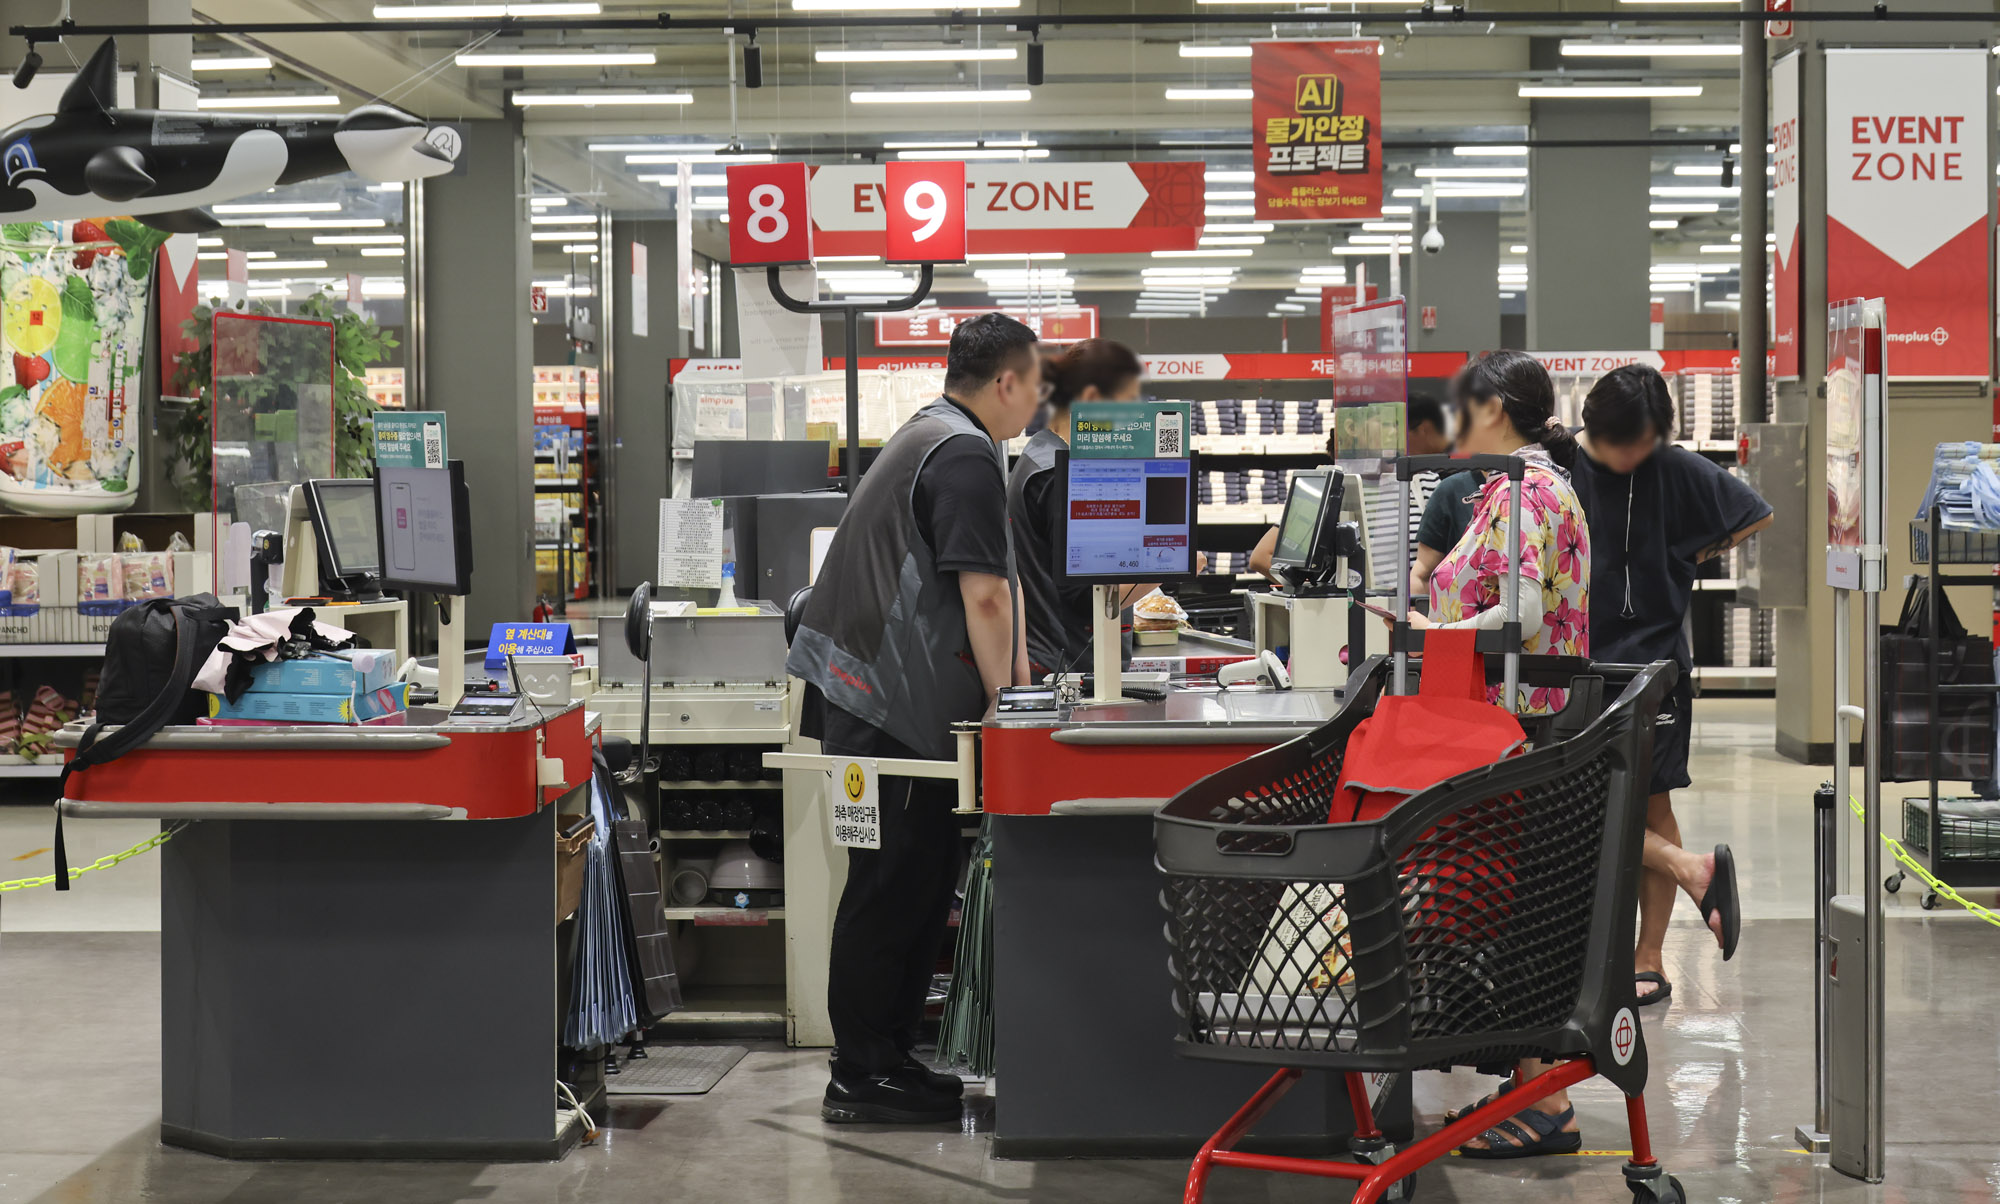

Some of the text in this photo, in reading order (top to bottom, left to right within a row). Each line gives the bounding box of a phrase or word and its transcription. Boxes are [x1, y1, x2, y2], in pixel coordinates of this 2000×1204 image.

[1299, 79, 1332, 107] AI
[1266, 115, 1364, 144] 물가안정
[1773, 118, 1796, 153] EVENT
[1851, 116, 1964, 144] EVENT
[1267, 144, 1365, 171] 프로젝트
[1851, 152, 1963, 181] ZONE
[1773, 155, 1796, 189] ZONE
[986, 181, 1094, 212] ZONE
[1292, 187, 1339, 196] 홈플러스 AI로
[1317, 196, 1340, 206] 장보기
[746, 183, 789, 243] 8
[903, 180, 947, 243] 9
[1157, 360, 1204, 375] ZONE
[1077, 433, 1132, 443] 미리 말씀해 주세요
[0, 625, 28, 634] ANCHO
[505, 628, 553, 640] 옆 계산대를
[498, 643, 554, 655] 이용해 주십시오
[834, 805, 877, 824] 좌측 매장입구를
[835, 825, 877, 844] 이용해주십시오
